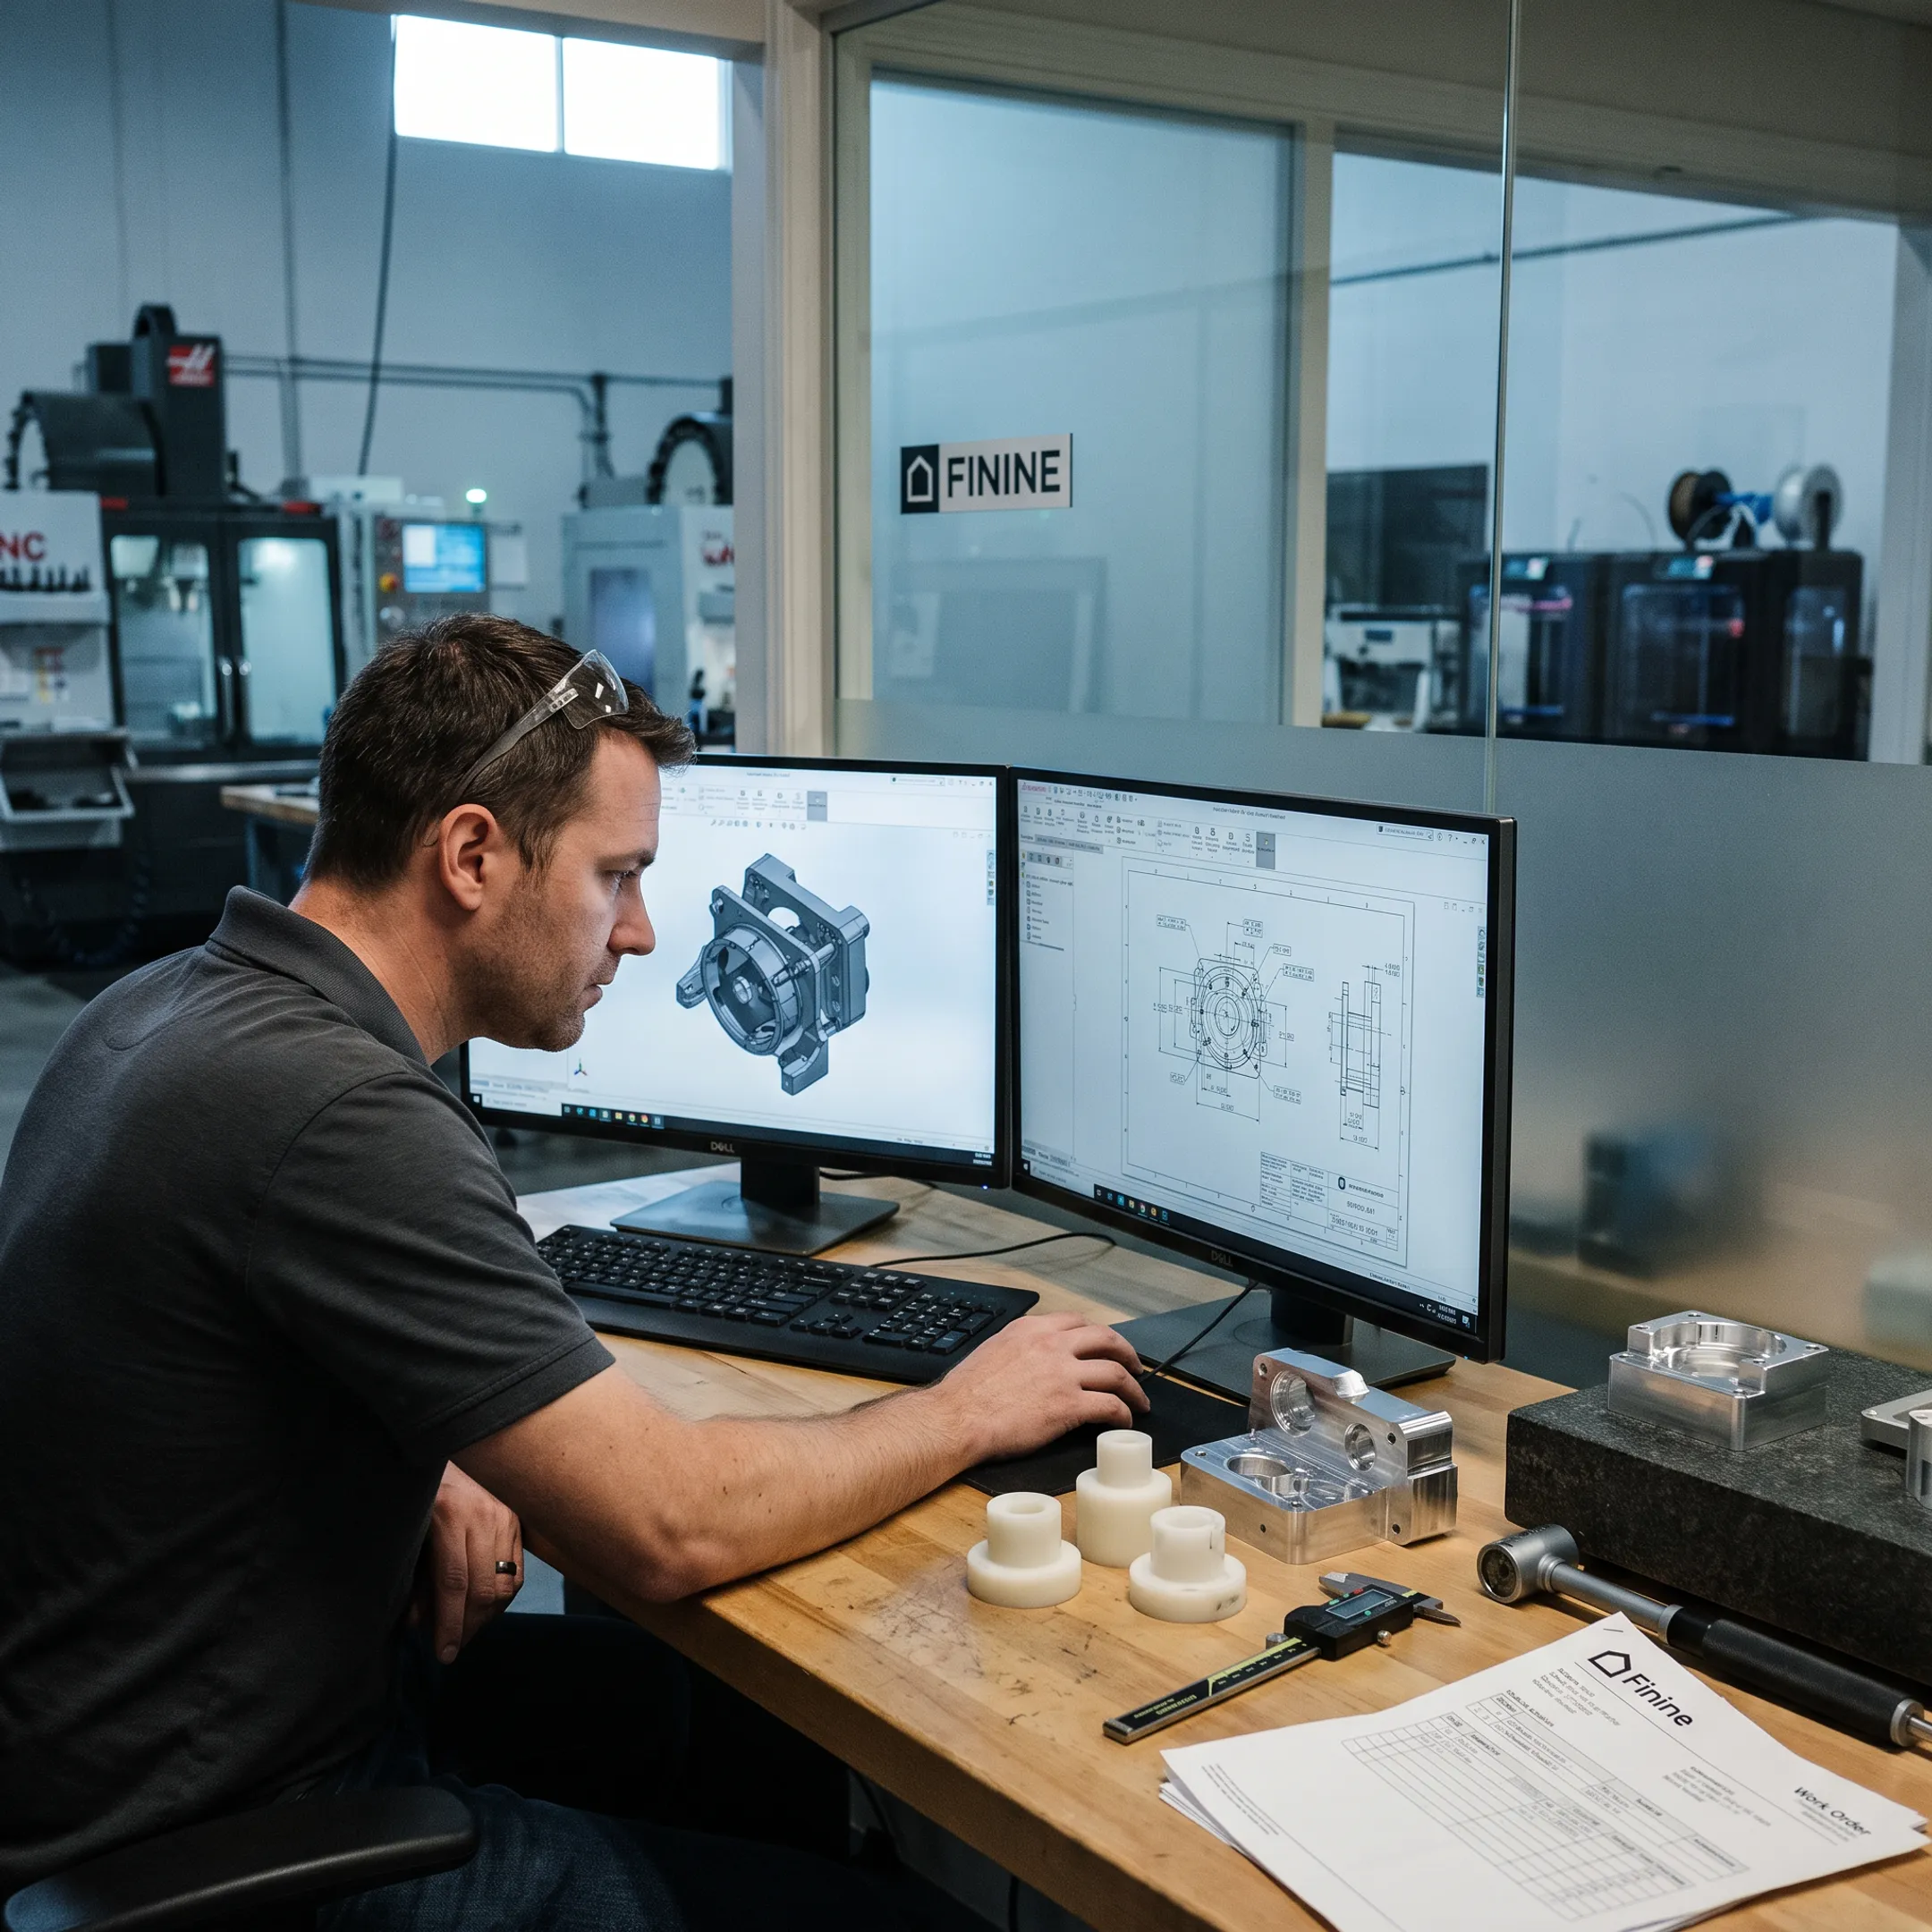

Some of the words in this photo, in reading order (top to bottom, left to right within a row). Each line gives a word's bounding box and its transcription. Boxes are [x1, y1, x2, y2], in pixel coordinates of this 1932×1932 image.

[947, 449, 1061, 497] FININE
[710, 1141, 735, 1153] DELL
[1621, 1673, 1694, 1727] Finine
[1793, 1786, 1830, 1810] Work
[1830, 1809, 1872, 1835] Order
